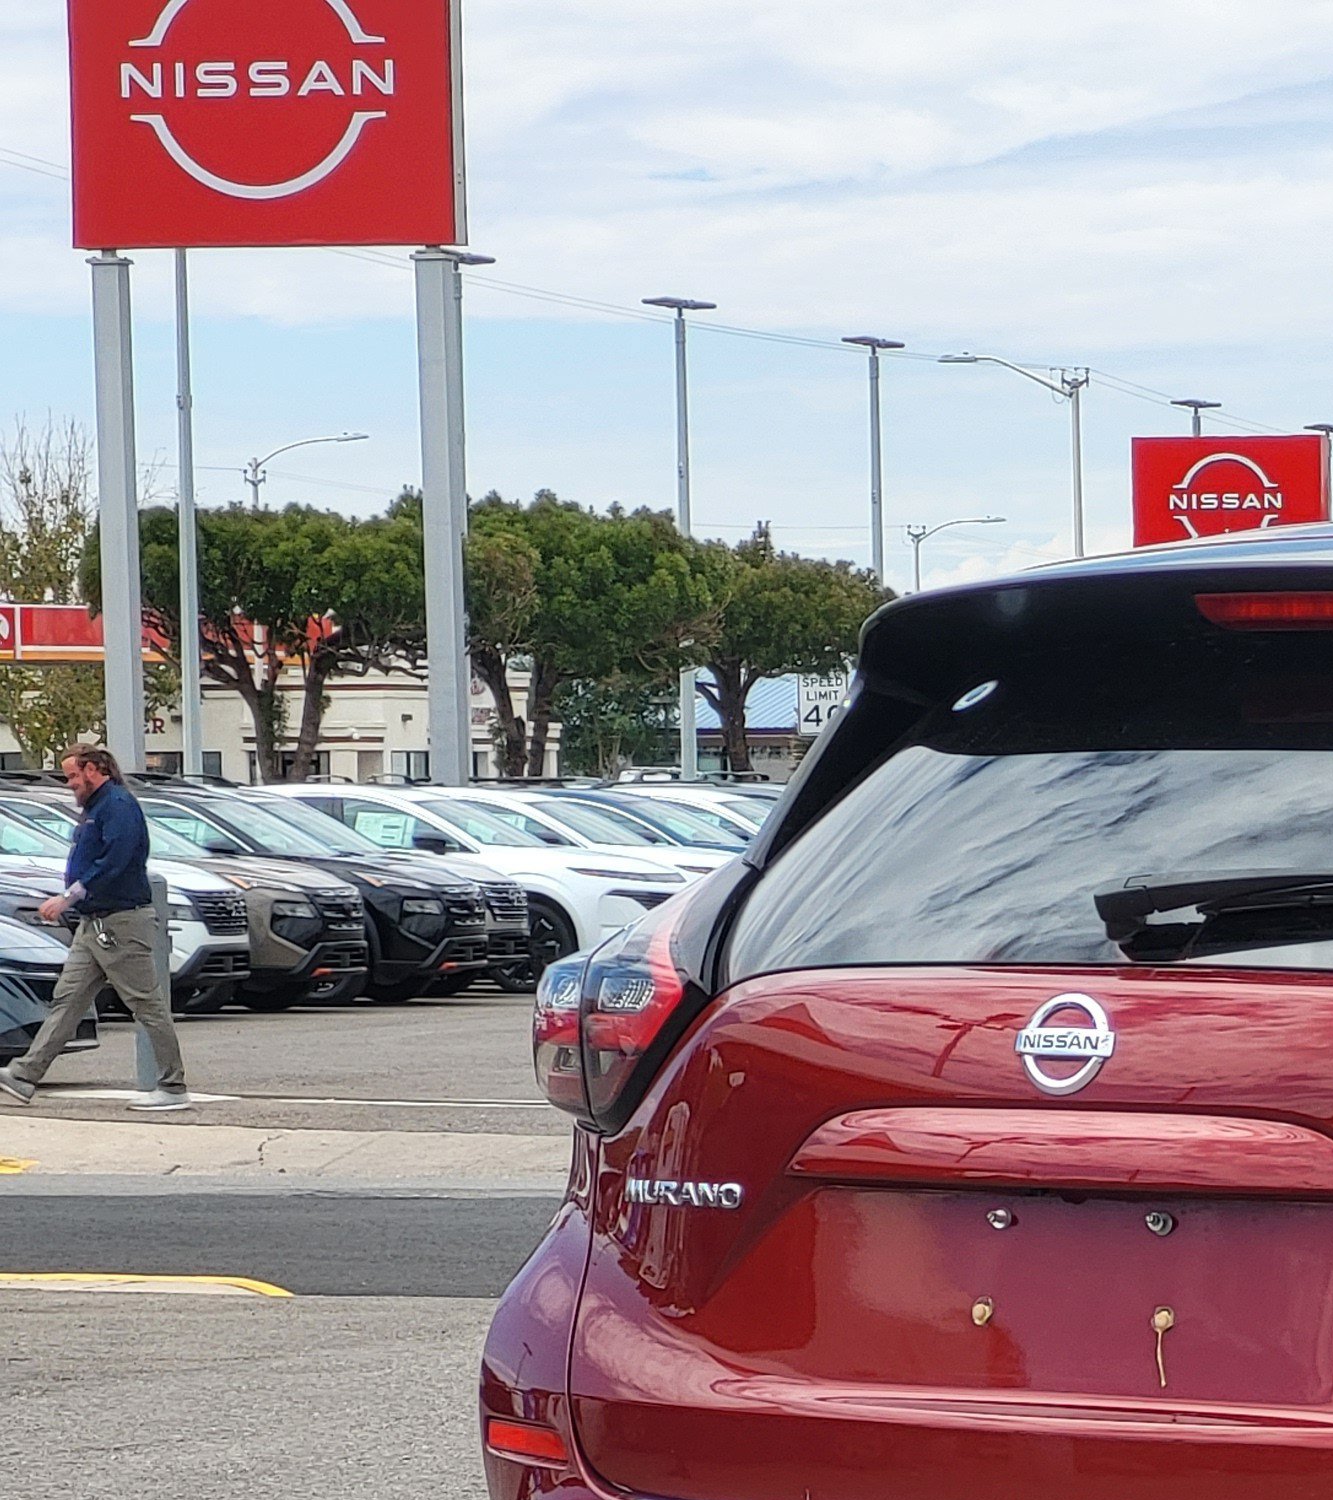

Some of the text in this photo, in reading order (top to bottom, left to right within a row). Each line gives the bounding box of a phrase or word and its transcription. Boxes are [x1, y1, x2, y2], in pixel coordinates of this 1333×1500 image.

[119, 58, 395, 99] NISSAN
[1169, 492, 1282, 510] NISSAN
[802, 677, 843, 687] SPEED
[806, 690, 839, 701] LIMIT
[1023, 1034, 1100, 1050] NISSAN
[625, 1178, 743, 1209] MURANO
